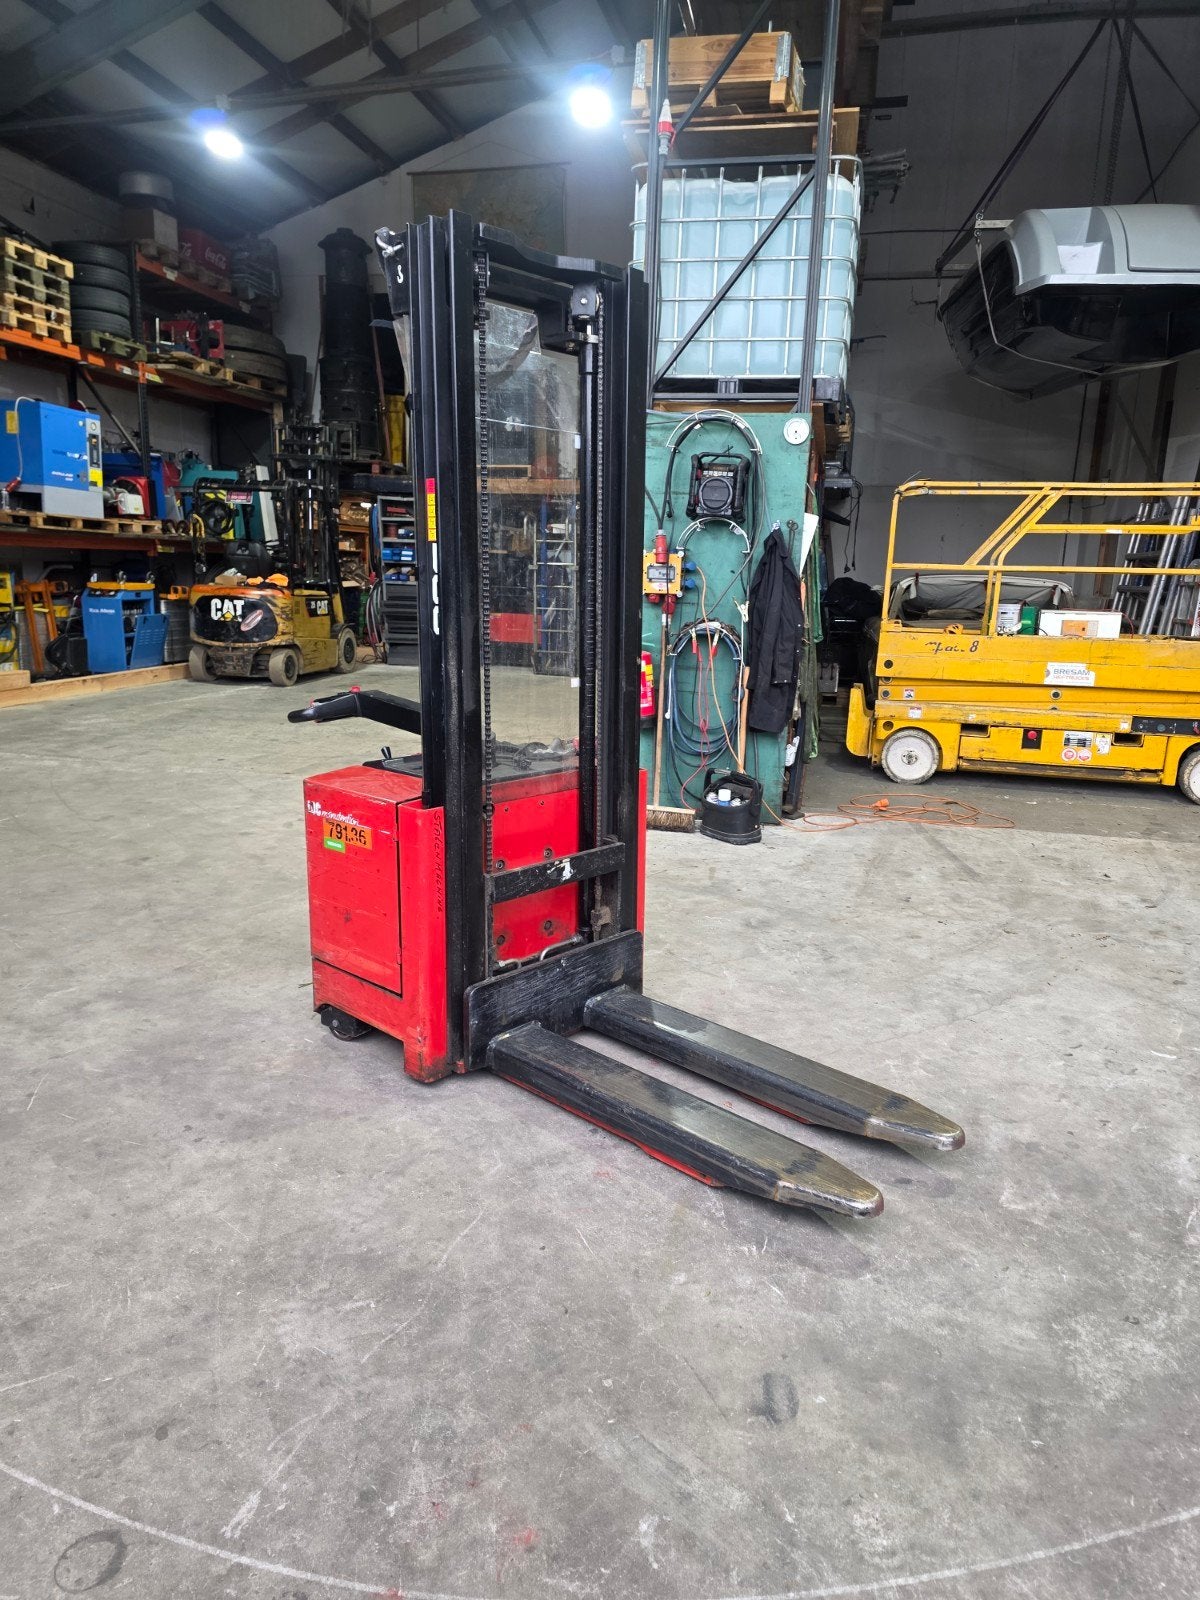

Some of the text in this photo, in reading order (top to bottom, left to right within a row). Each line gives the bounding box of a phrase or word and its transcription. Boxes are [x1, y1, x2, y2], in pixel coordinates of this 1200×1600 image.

[210, 598, 245, 621] CAT
[316, 600, 329, 615] CAT
[969, 640, 980, 653] 8
